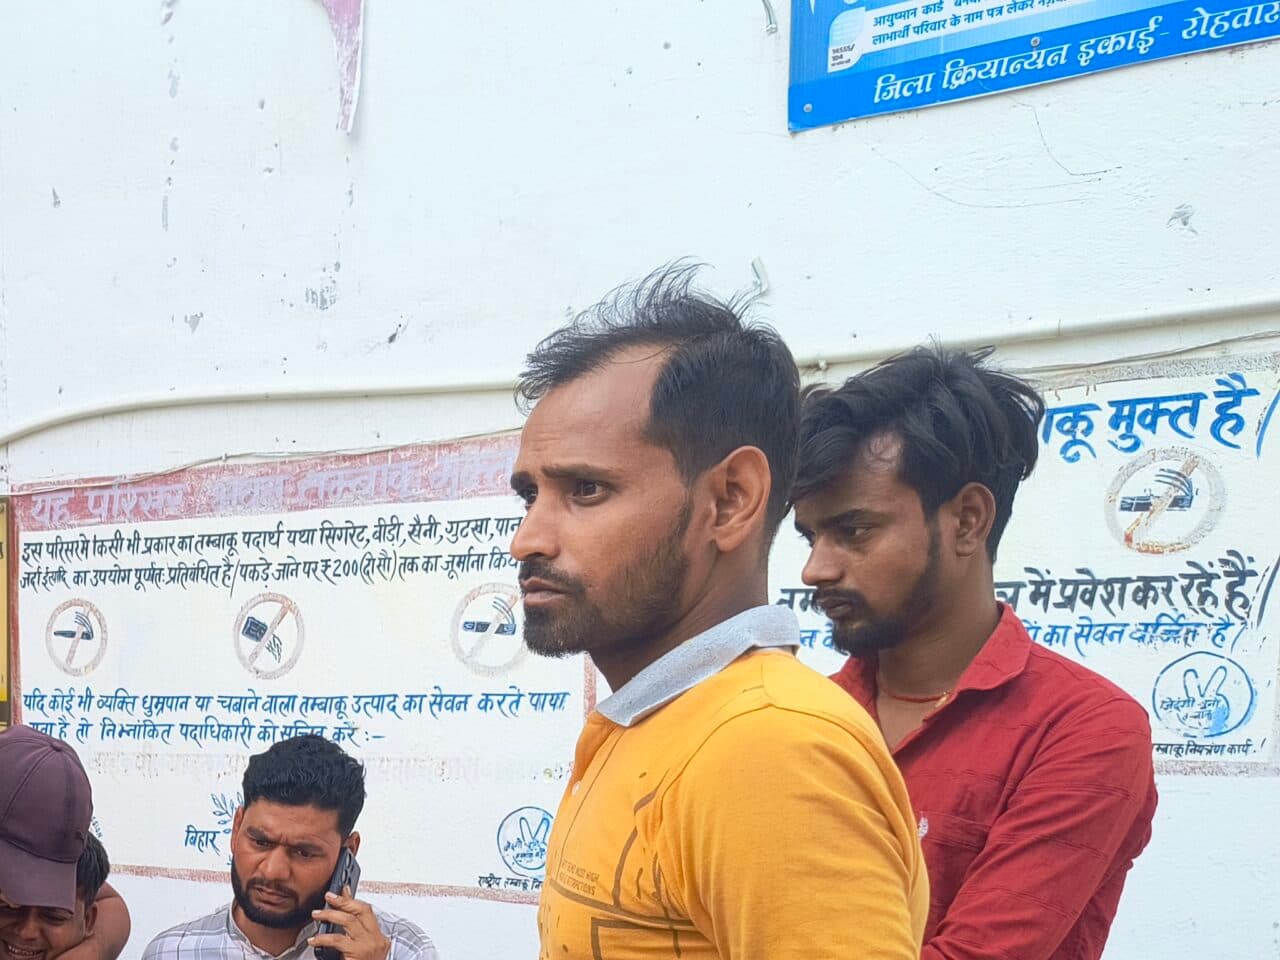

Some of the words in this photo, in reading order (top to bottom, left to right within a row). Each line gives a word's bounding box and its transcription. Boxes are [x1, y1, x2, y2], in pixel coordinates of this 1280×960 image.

[872, 24, 909, 45] लाभार्थी
[912, 17, 947, 36] परिवार
[950, 14, 961, 27] के
[964, 11, 983, 23] नाम
[987, 6, 1003, 18] पत्र
[873, 74, 935, 103] जिला
[1107, 392, 1208, 453] मुक्त
[22, 542, 43, 568] इस
[93, 529, 125, 560] किसी
[126, 529, 141, 555] भी
[141, 536, 178, 556] प्रकार
[177, 535, 194, 554] का
[194, 532, 238, 557] तम्बाकू
[241, 520, 284, 553] पदार्थ
[286, 528, 317, 547] यथा
[72, 570, 90, 587] का
[90, 564, 132, 587] उपयोग
[271, 555, 301, 581] जाने
[302, 560, 322, 582] पर
[399, 556, 420, 583] तक
[421, 554, 442, 574] का
[1023, 566, 1057, 613] में
[1053, 568, 1131, 617] प्रवेश
[1131, 576, 1178, 613] कर
[1043, 621, 1072, 647] का
[1073, 615, 1131, 658] सेवन
[23, 688, 49, 718] यदि
[48, 687, 76, 718] कोई
[77, 686, 95, 713] भी
[96, 687, 140, 716] व्यक्ति
[194, 695, 214, 712] या
[217, 688, 262, 715] चबाने
[261, 694, 298, 717] वाला
[299, 696, 349, 719] तम्बाकू
[351, 693, 403, 720] उत्पाद
[402, 694, 428, 714] का
[429, 685, 473, 720] सेवन
[75, 717, 94, 744] तो
[179, 715, 256, 748] पदाधिकारी
[257, 719, 279, 743] को
[1152, 743, 1183, 758] म्बाकू
